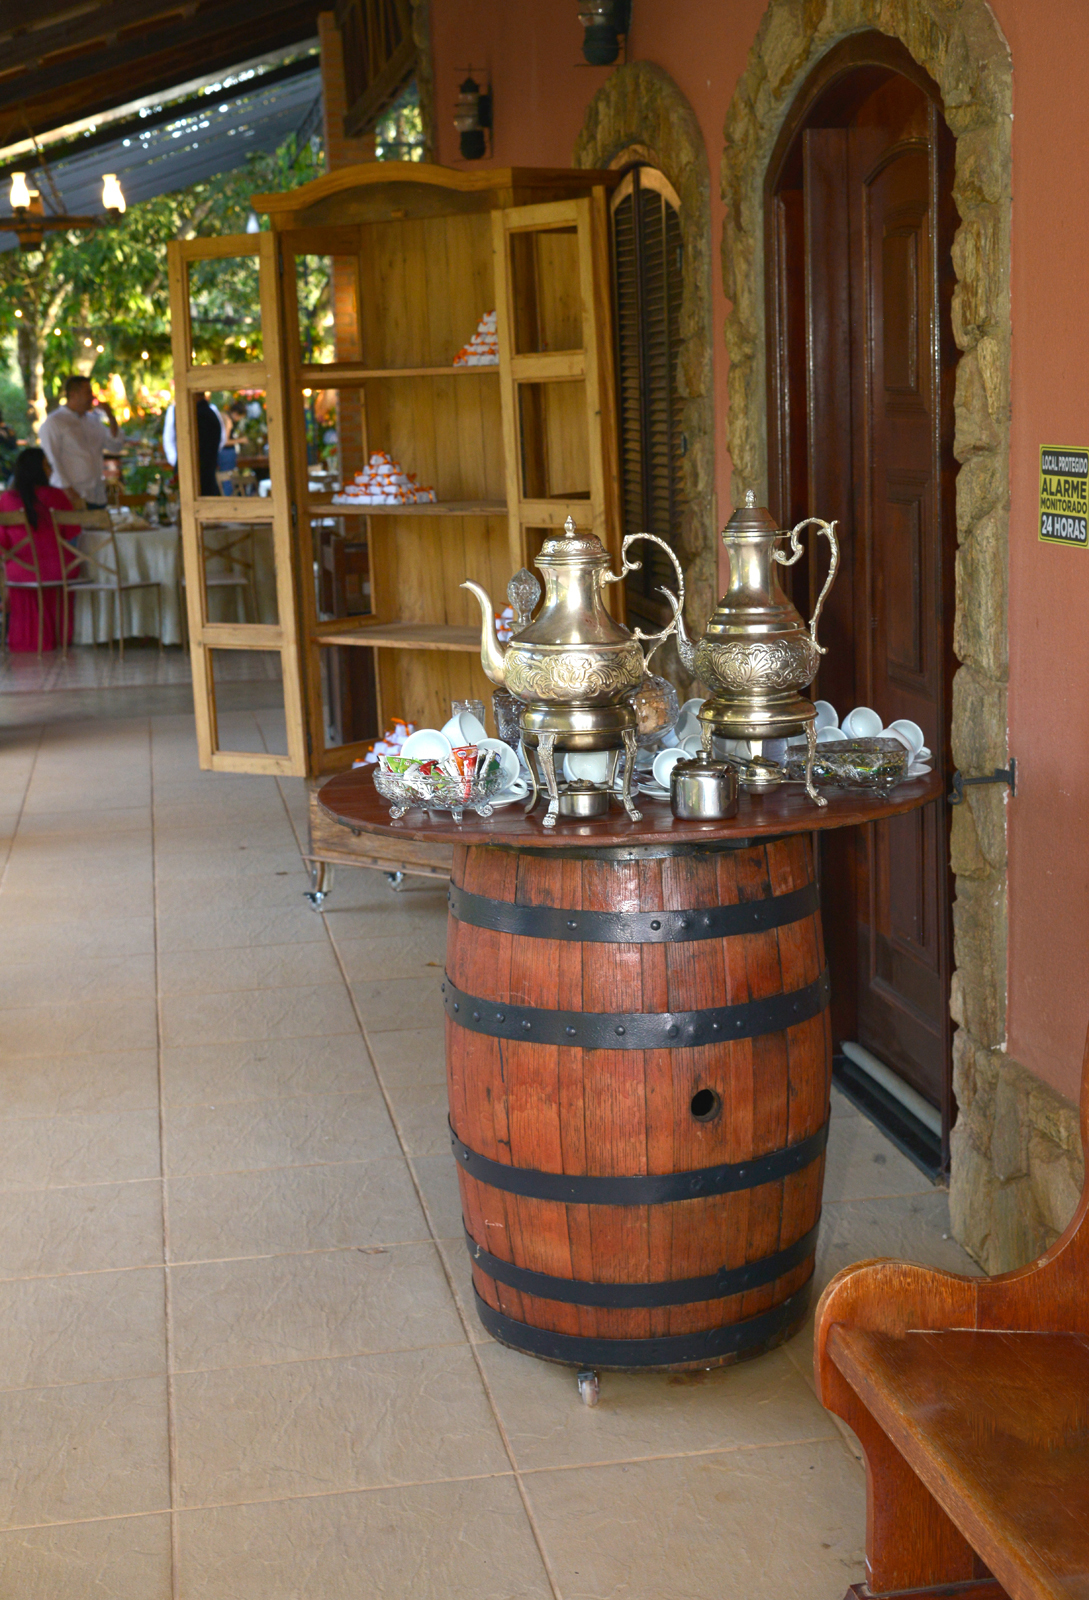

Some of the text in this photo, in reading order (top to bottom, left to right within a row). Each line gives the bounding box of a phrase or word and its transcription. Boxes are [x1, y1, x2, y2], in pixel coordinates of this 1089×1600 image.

[1042, 455, 1088, 473] LOCAL PROTEGIDO
[1041, 477, 1087, 500] ALARME
[1041, 497, 1088, 514] MONITORADO
[1042, 515, 1086, 540] 24 HORAS
